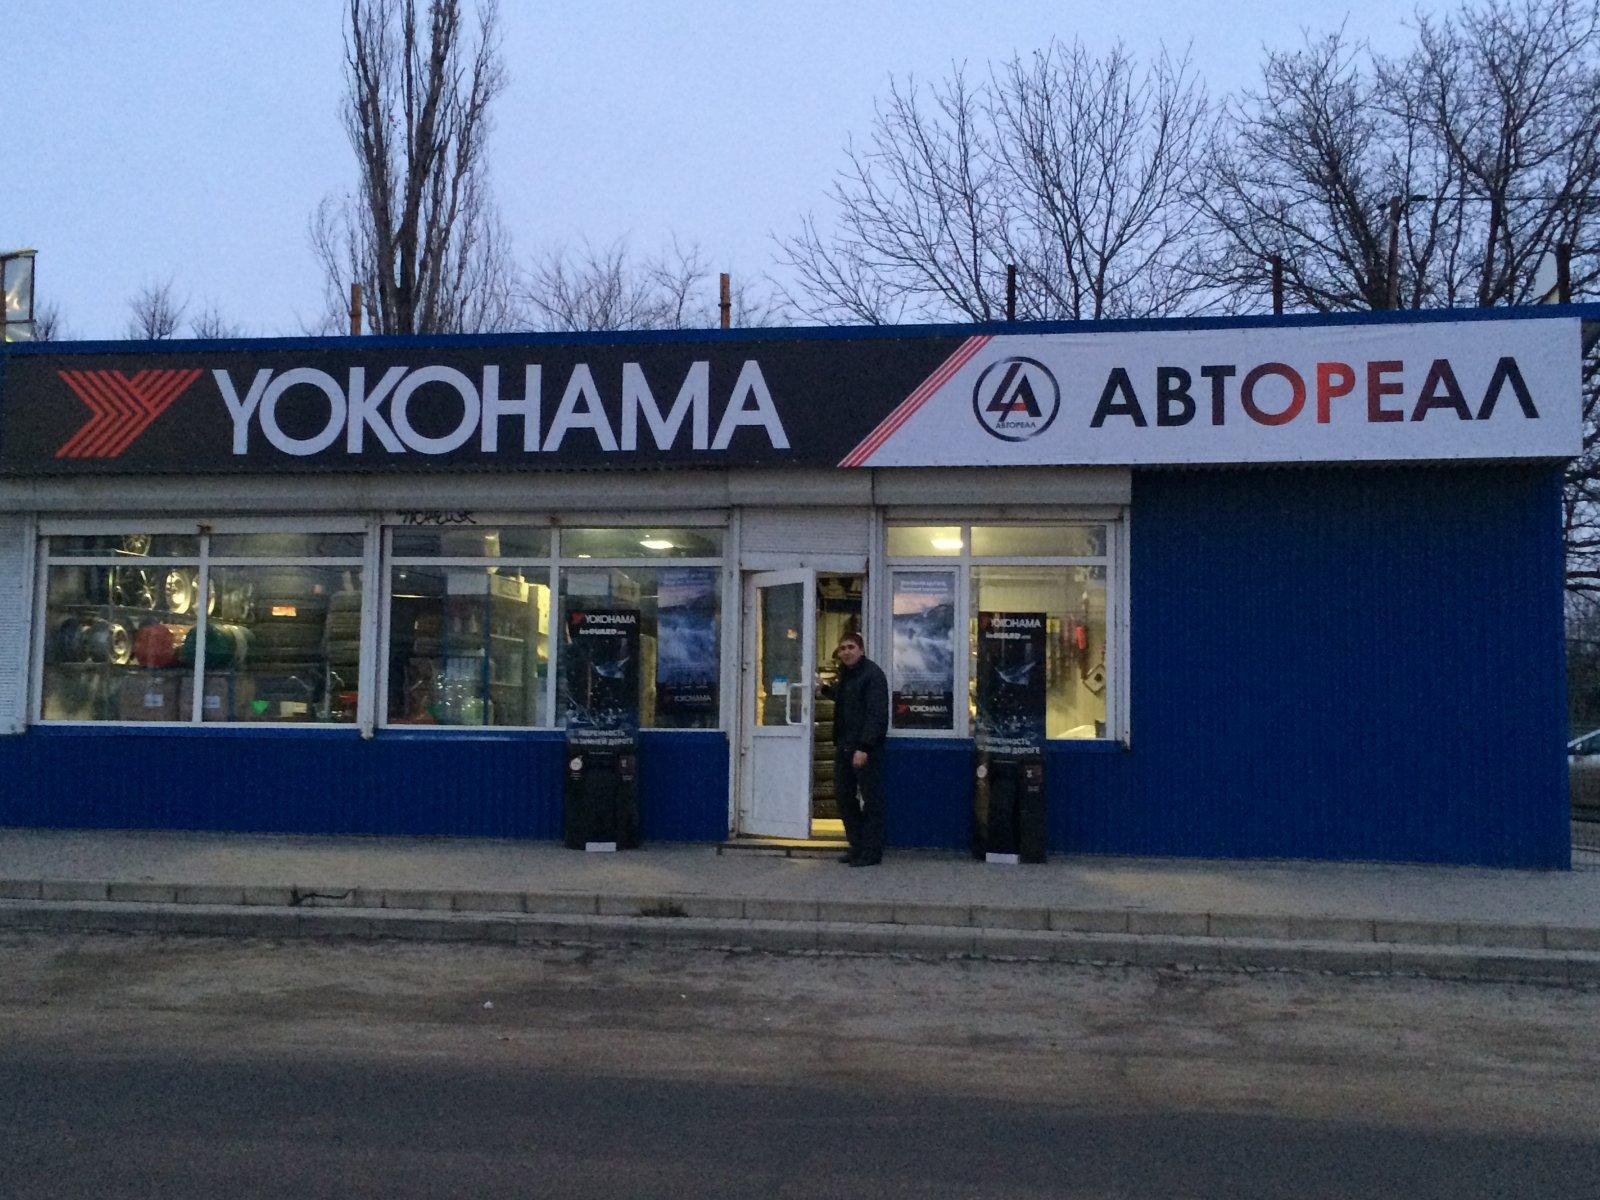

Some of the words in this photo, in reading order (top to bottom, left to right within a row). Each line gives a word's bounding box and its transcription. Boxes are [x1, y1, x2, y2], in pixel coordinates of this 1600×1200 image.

[212, 359, 790, 456] YOKOHAMA
[1089, 356, 1540, 428] АВТОРЕАЛ
[584, 614, 636, 624] YOKOHAMA
[990, 618, 1041, 628] YOKOHAMA
